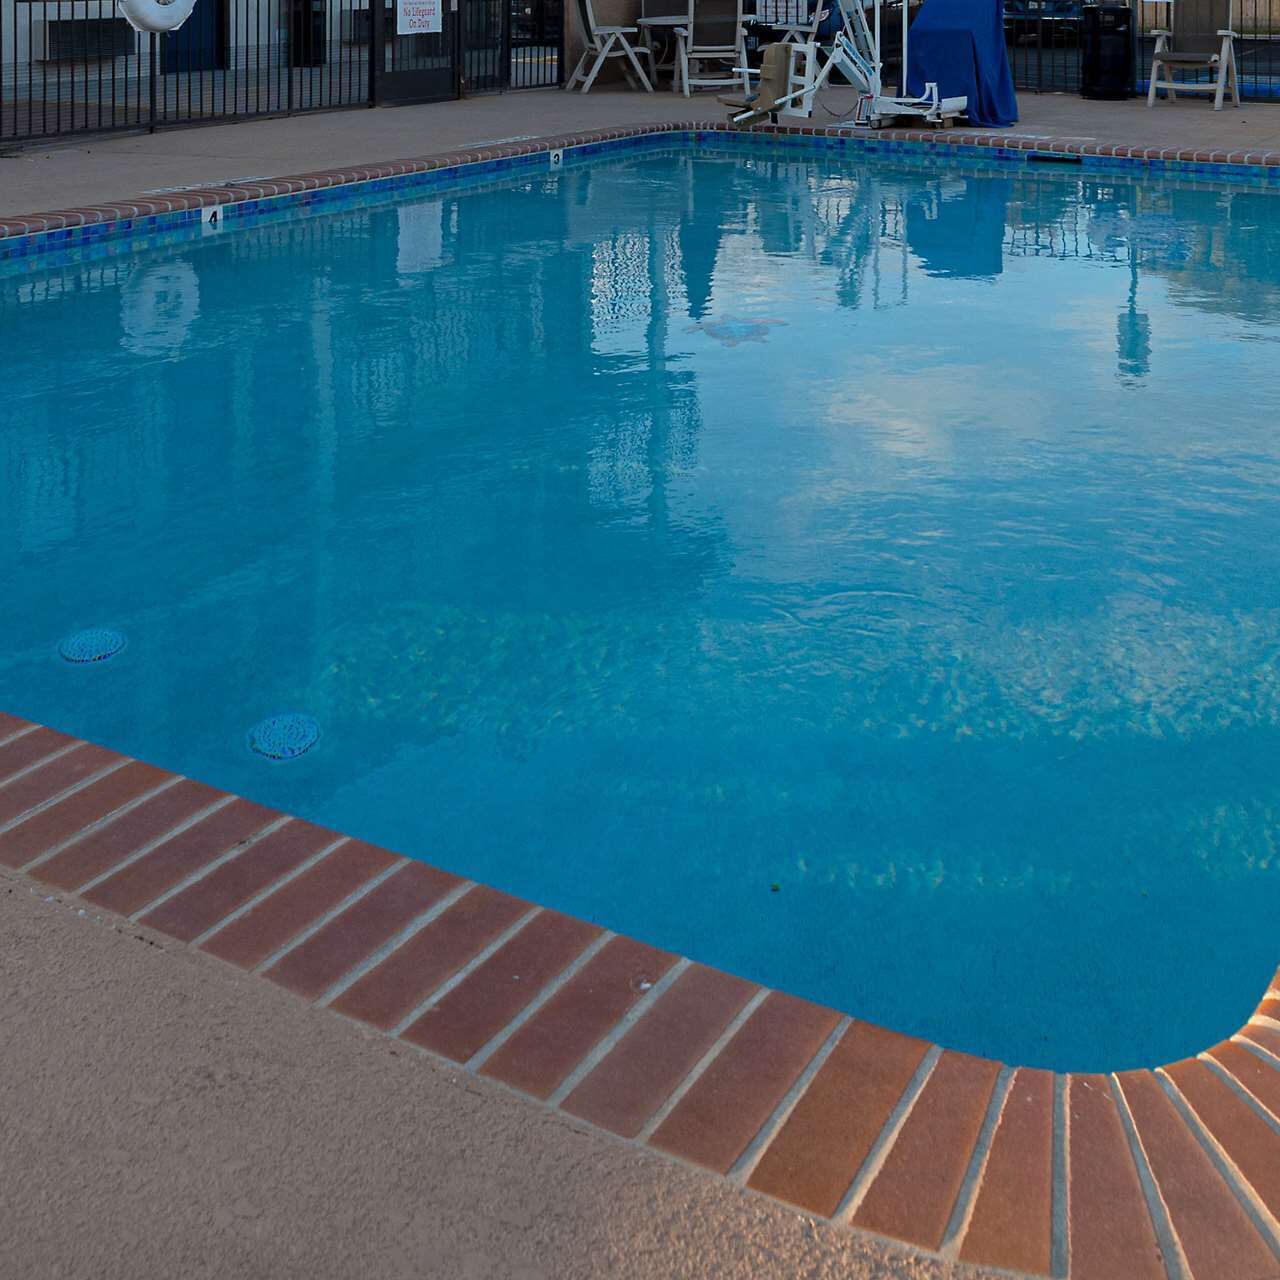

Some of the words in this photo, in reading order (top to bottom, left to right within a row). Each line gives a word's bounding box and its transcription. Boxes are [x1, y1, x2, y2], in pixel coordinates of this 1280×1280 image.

[403, 7, 411, 16] No
[412, 6, 436, 18] Lifeguard
[409, 19, 417, 28] On
